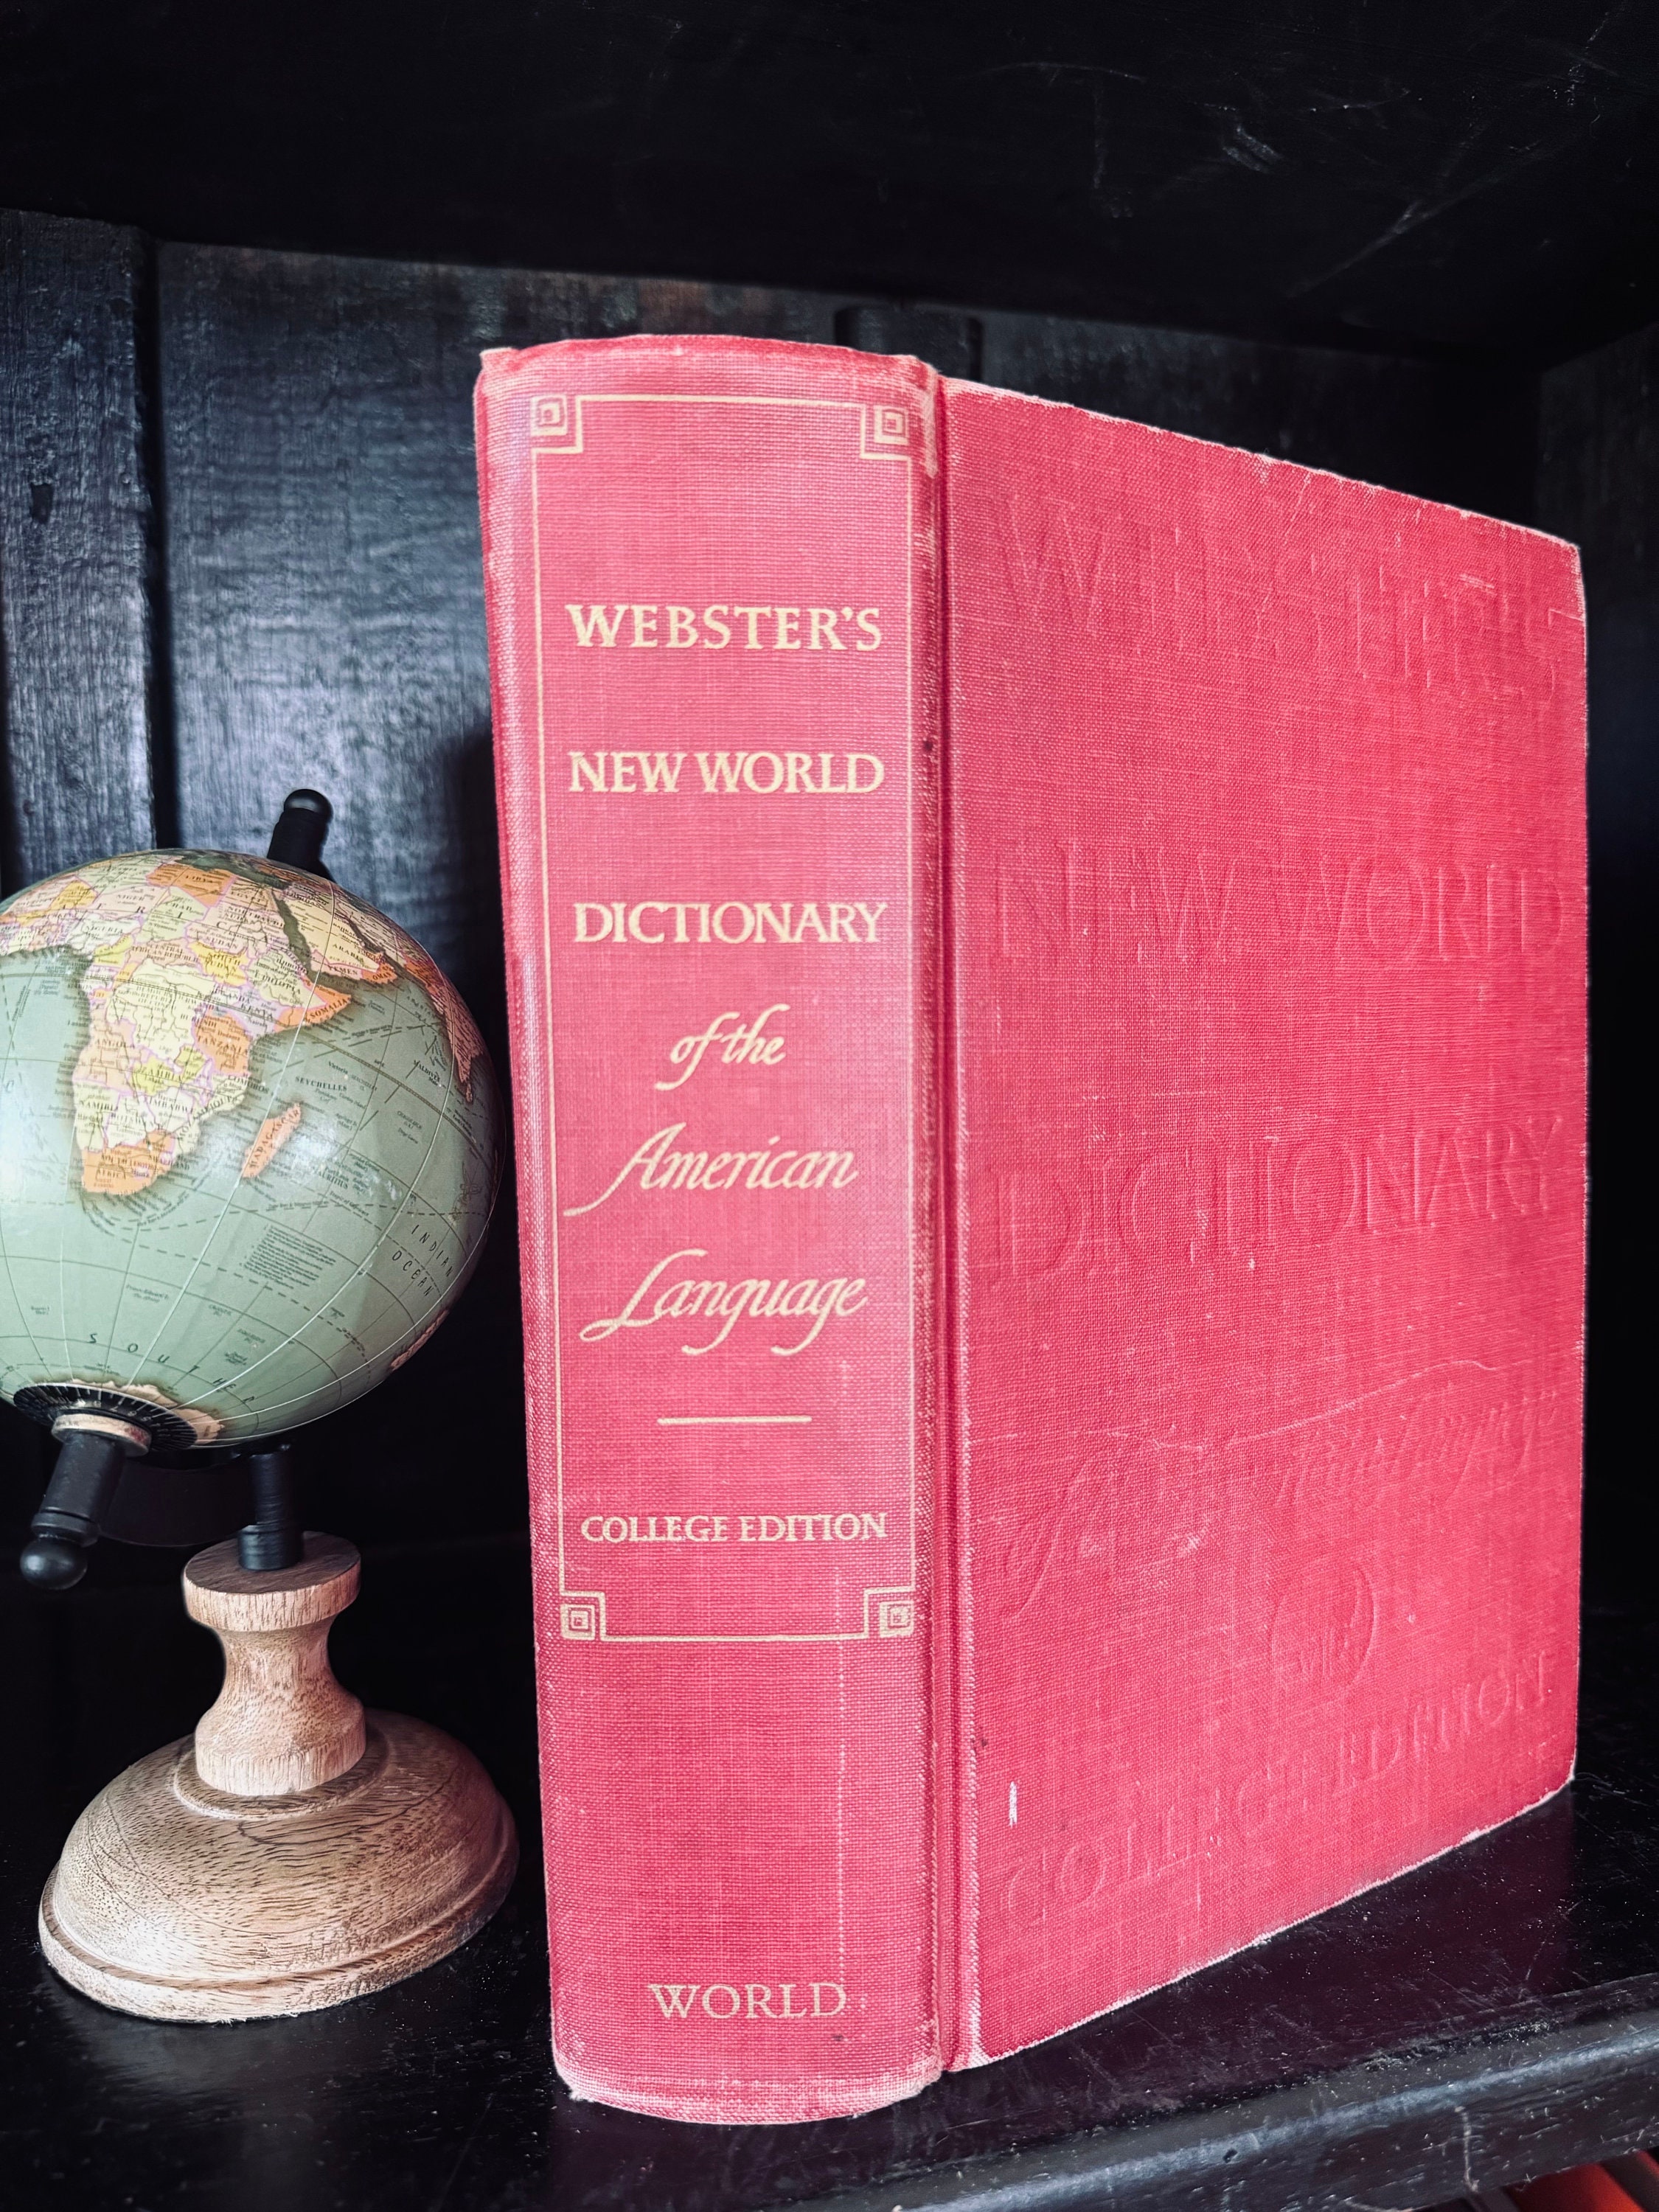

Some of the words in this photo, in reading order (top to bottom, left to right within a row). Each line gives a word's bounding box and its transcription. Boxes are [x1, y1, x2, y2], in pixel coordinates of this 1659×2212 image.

[565, 604, 883, 651] WEBSTER'S
[567, 751, 687, 793] NEW
[695, 751, 885, 794] WORLD
[573, 902, 888, 944] DICTIONARY
[310, 998, 347, 1019] SOMALIA
[654, 1010, 740, 1091] of
[720, 1004, 790, 1065] the
[295, 1076, 347, 1092] SEYCHELLES
[563, 1121, 859, 1217] American
[411, 1224, 453, 1277] INDIAN
[392, 1250, 434, 1296] OCEAN
[579, 1248, 869, 1355] Language
[580, 1514, 728, 1544] COLLEGE
[737, 1512, 888, 1543] EDITION
[647, 1982, 849, 2020] WORLD
